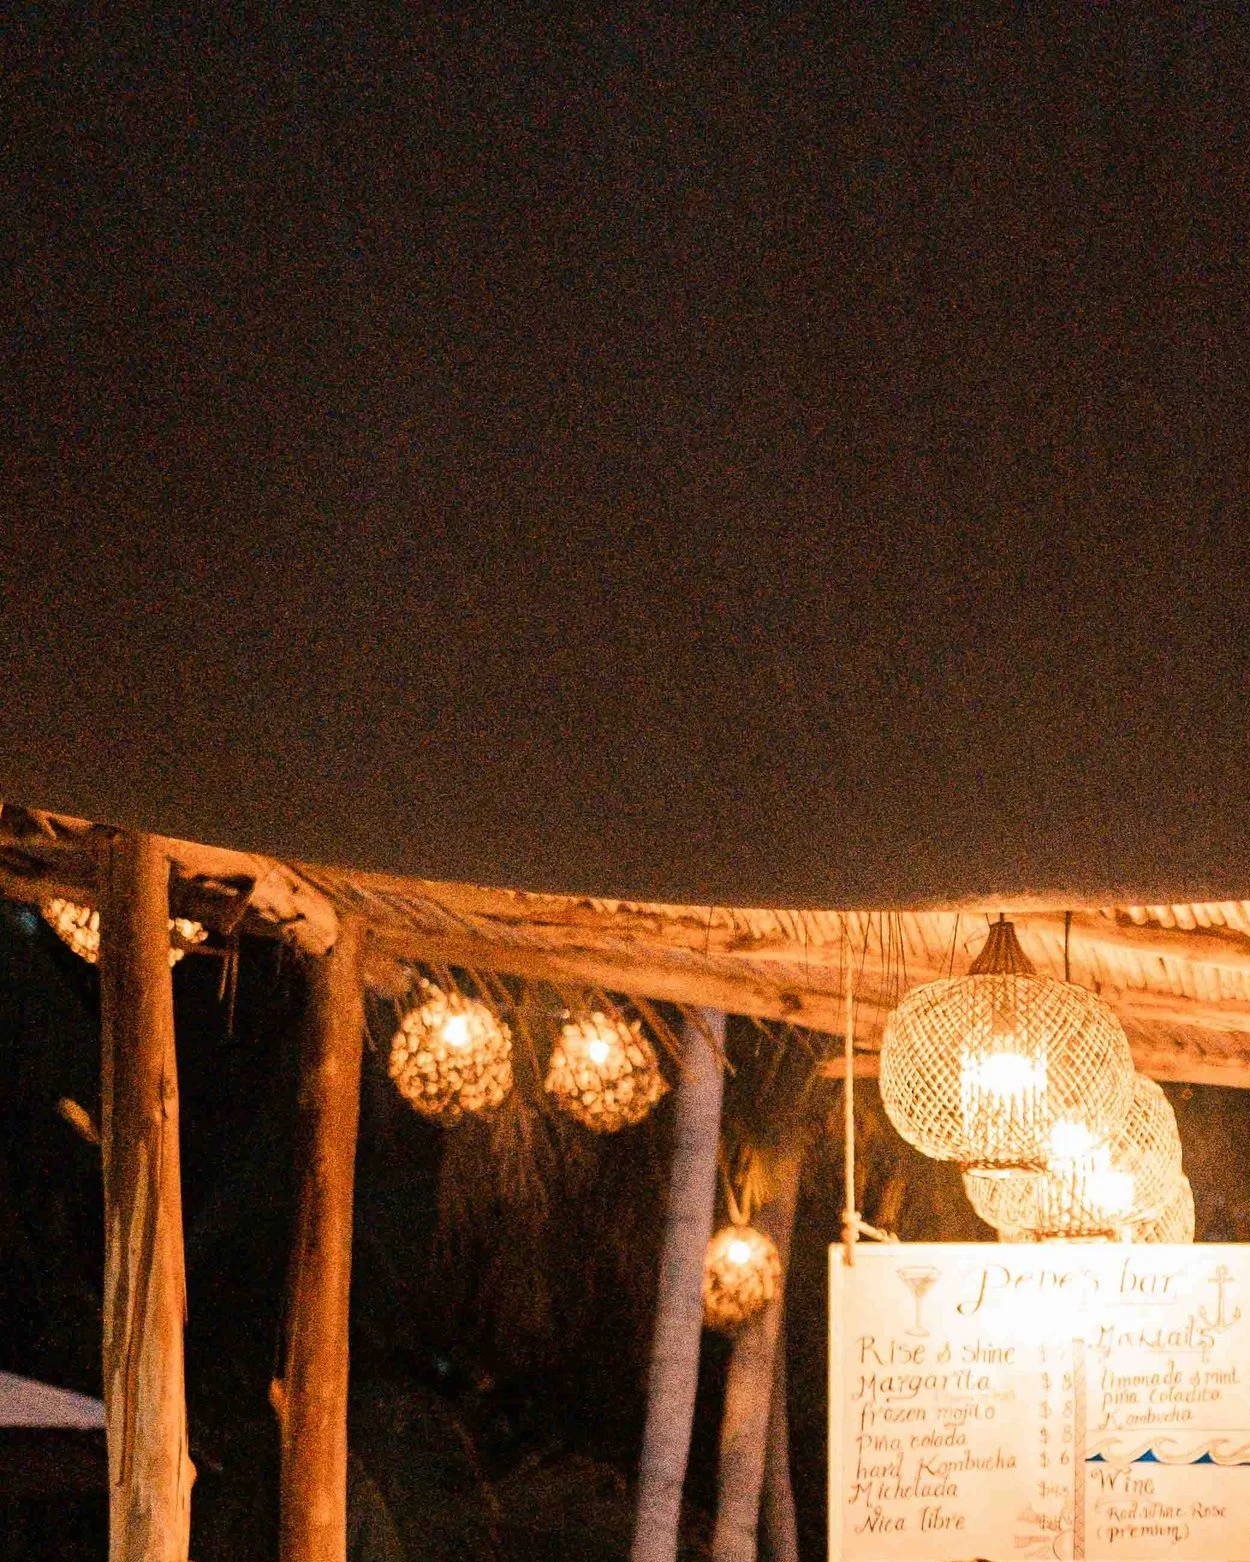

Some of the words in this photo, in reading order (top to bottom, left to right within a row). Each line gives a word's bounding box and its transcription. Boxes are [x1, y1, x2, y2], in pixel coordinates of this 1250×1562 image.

[1119, 1257, 1178, 1296] bar
[856, 1335, 926, 1366] Rise
[850, 1369, 992, 1403] Margarita
[1098, 1407, 1194, 1431] Kombucha
[909, 1429, 968, 1450] colada
[914, 1448, 1017, 1485] Kombucha
[1060, 1451, 1070, 1466] 6
[1091, 1467, 1155, 1496] Wine
[848, 1476, 959, 1508] Michelada
